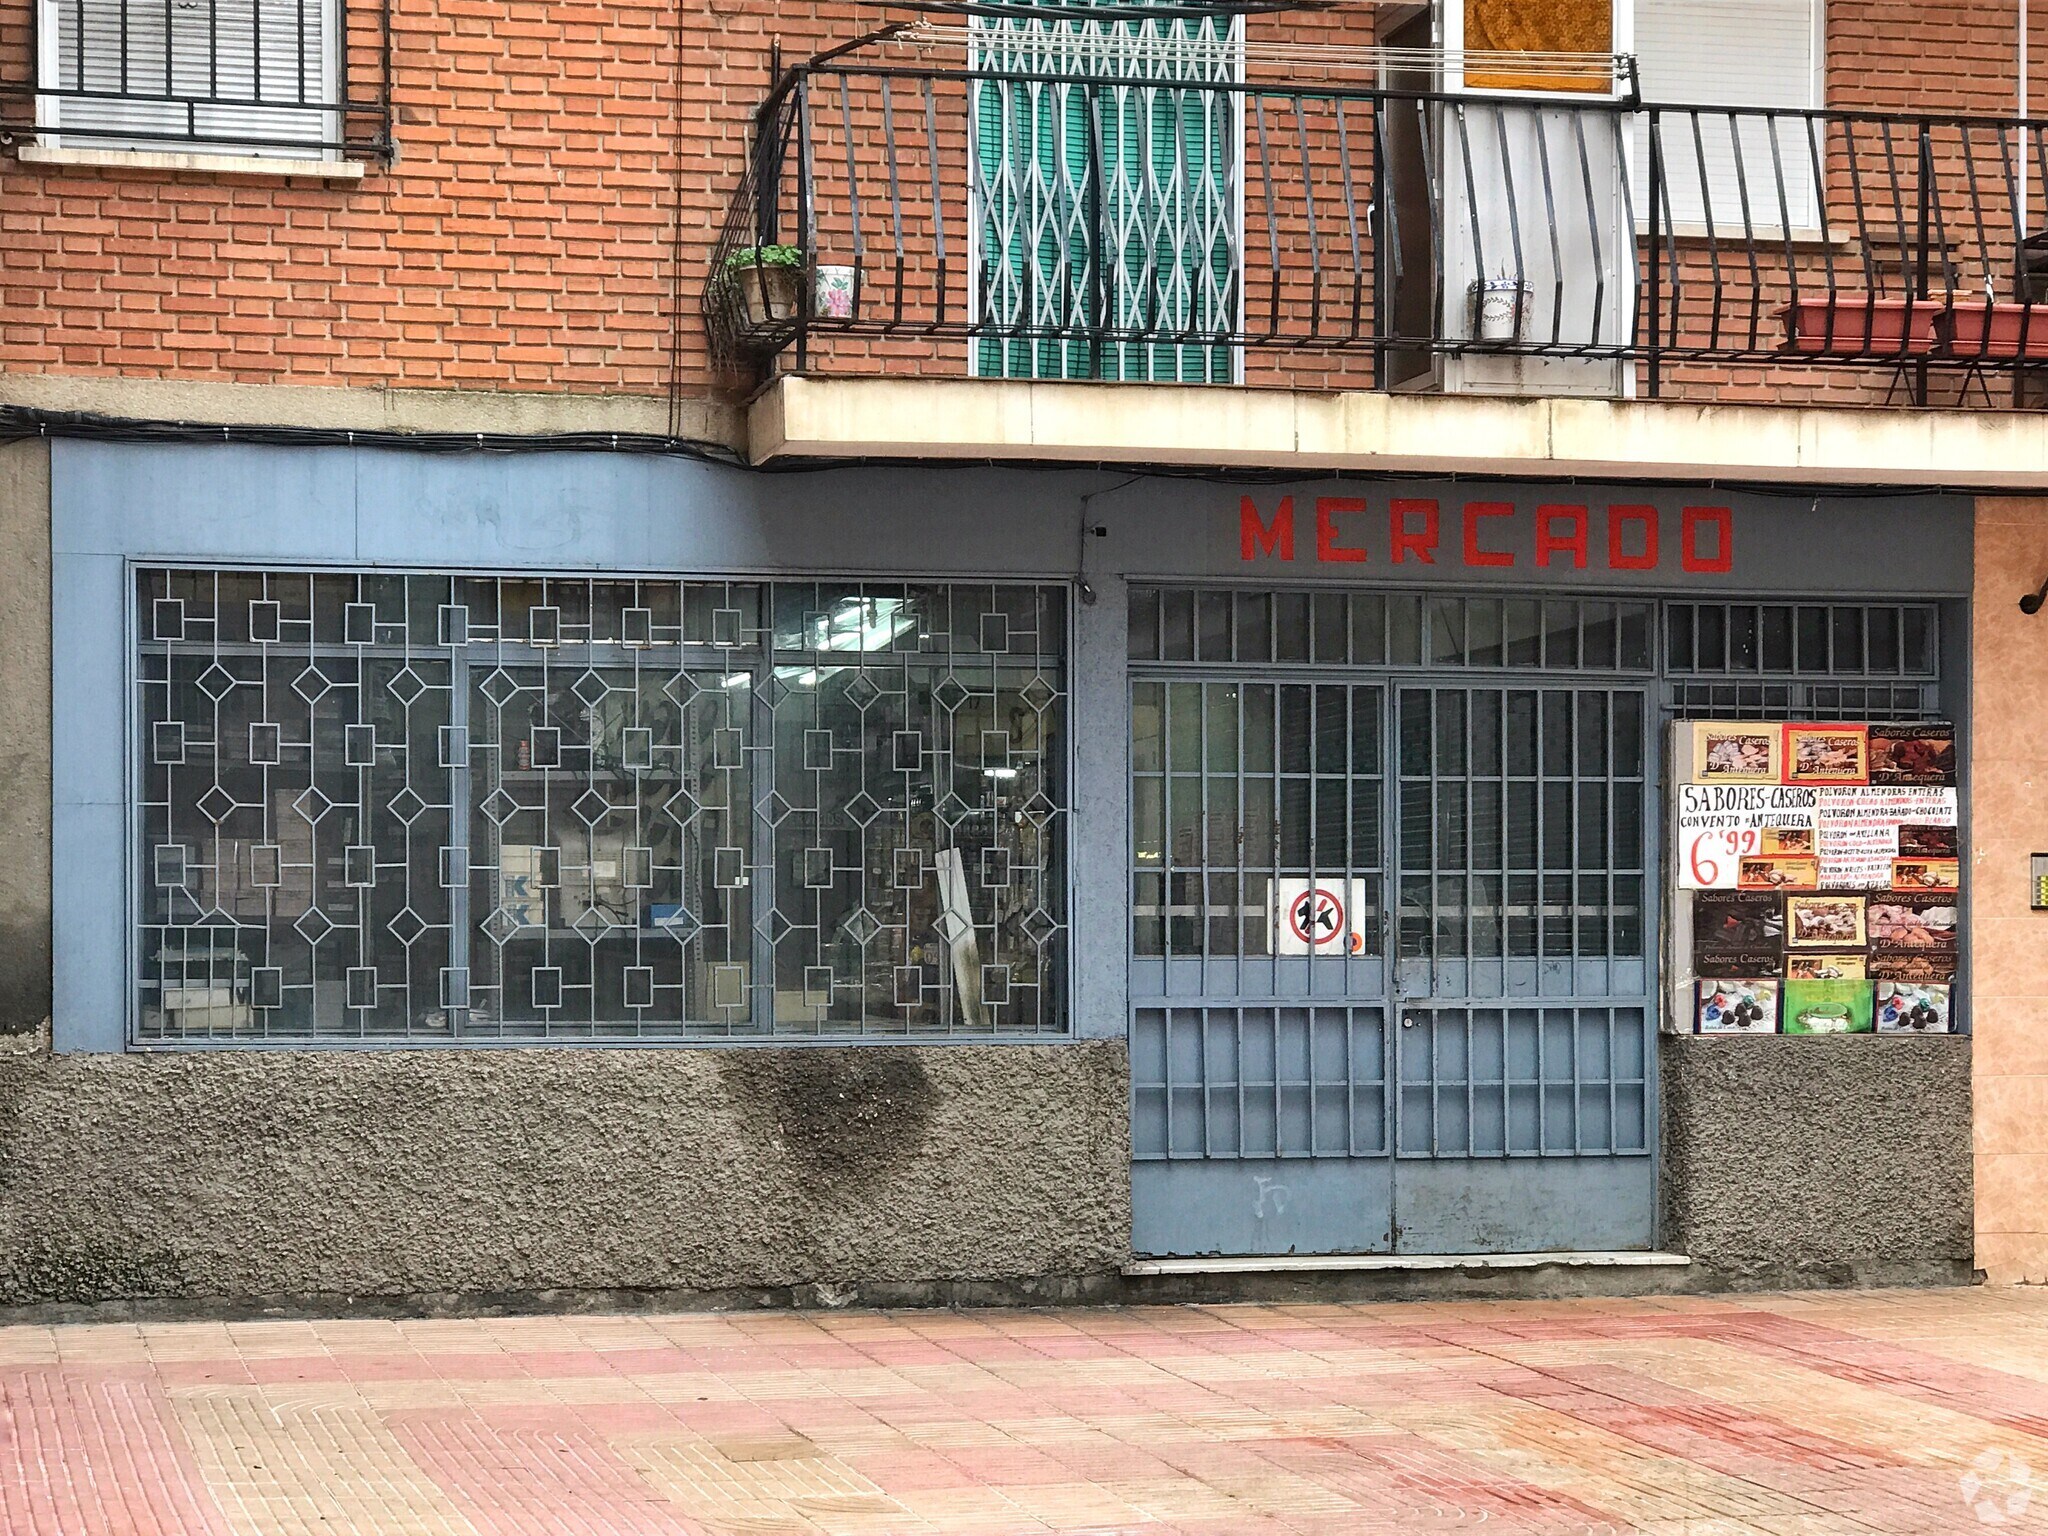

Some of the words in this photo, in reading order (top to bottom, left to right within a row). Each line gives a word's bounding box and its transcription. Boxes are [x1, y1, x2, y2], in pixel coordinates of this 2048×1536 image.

[1240, 495, 1733, 573] MERCADO
[1872, 728, 1910, 738] Sabores
[1913, 728, 1950, 737] Caseros
[1739, 736, 1771, 745] Caseros
[1828, 737, 1860, 746] Caseros
[1681, 815, 1740, 828] CONVENTO
[1701, 893, 1735, 902] Sabores
[1738, 891, 1772, 902] Caseros
[1873, 893, 1911, 903] Sabores
[1914, 893, 1953, 903] Caseros
[1703, 954, 1737, 964] Sabores
[1740, 954, 1774, 963] Caseros
